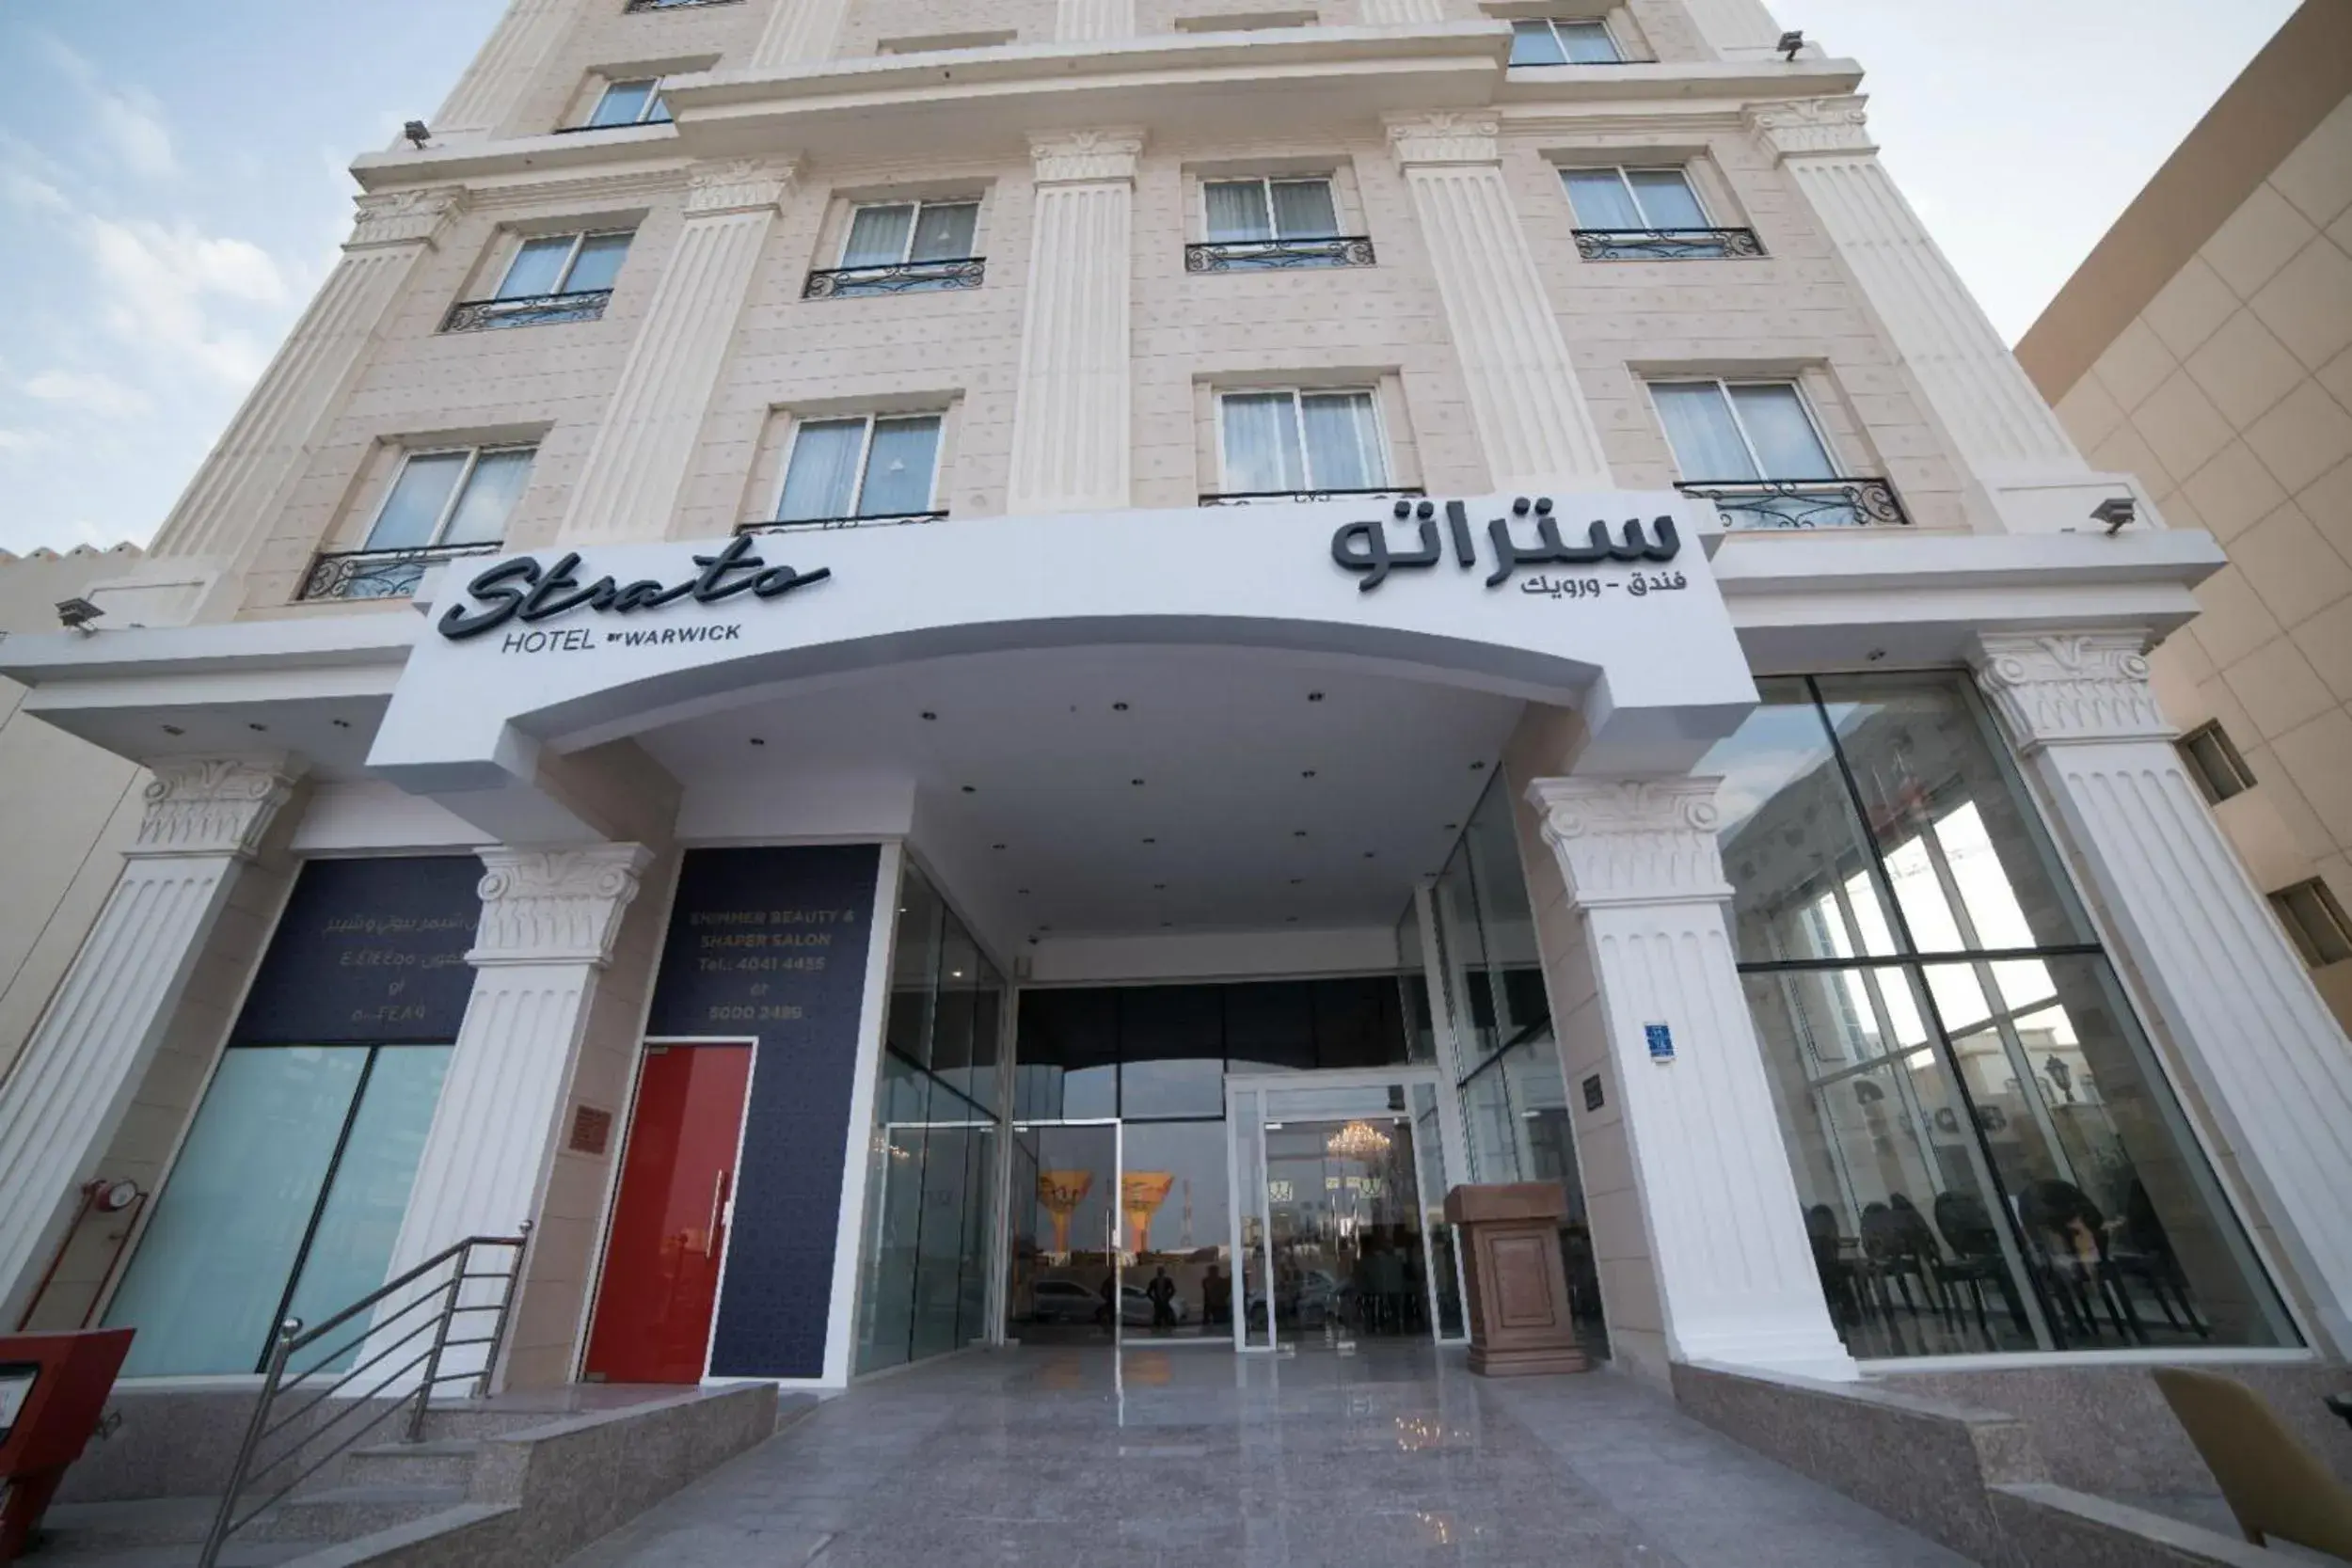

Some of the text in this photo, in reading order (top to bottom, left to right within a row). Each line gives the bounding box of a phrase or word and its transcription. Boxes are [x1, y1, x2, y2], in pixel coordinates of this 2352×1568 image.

[1331, 497, 1681, 593] ستراتو
[1627, 571, 1688, 597] فندق
[501, 628, 596, 654] HOTEL
[623, 624, 742, 648] WARWICK
[770, 910, 838, 925] BEAUTY
[699, 932, 832, 948] SHAPER SALON
